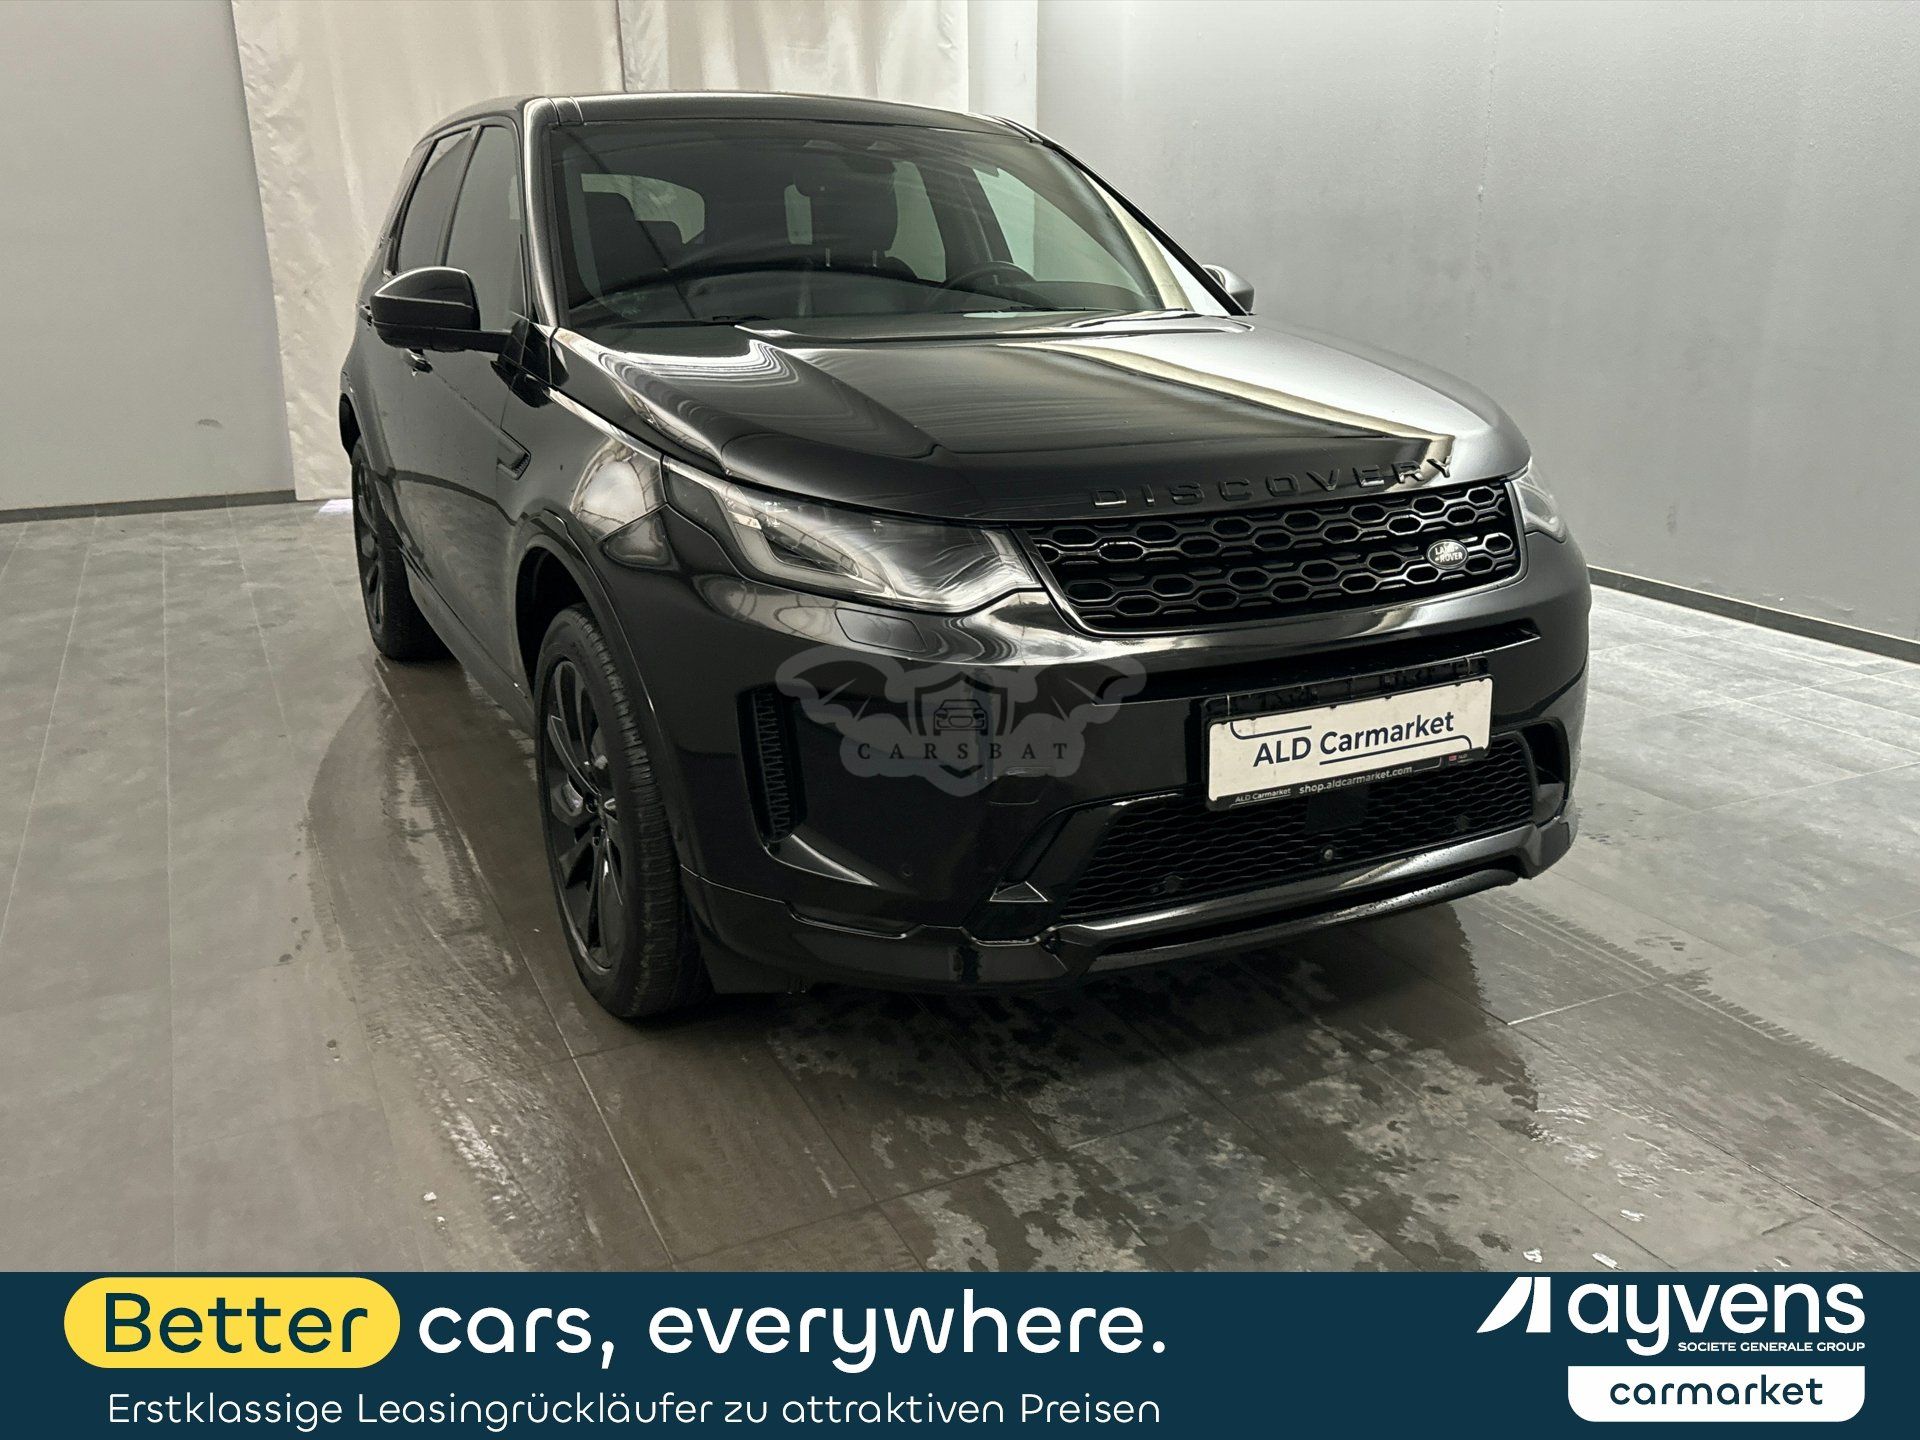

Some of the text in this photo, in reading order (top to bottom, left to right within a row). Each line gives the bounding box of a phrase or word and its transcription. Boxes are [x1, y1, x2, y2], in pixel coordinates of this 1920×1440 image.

[1094, 457, 1451, 507] DISCOVERY
[1440, 551, 1463, 563] ROVER
[1253, 711, 1455, 767] ALD Carmarket
[1234, 787, 1291, 803] ALD Carmarket
[1299, 764, 1413, 795] shop.aldcarmarket.com
